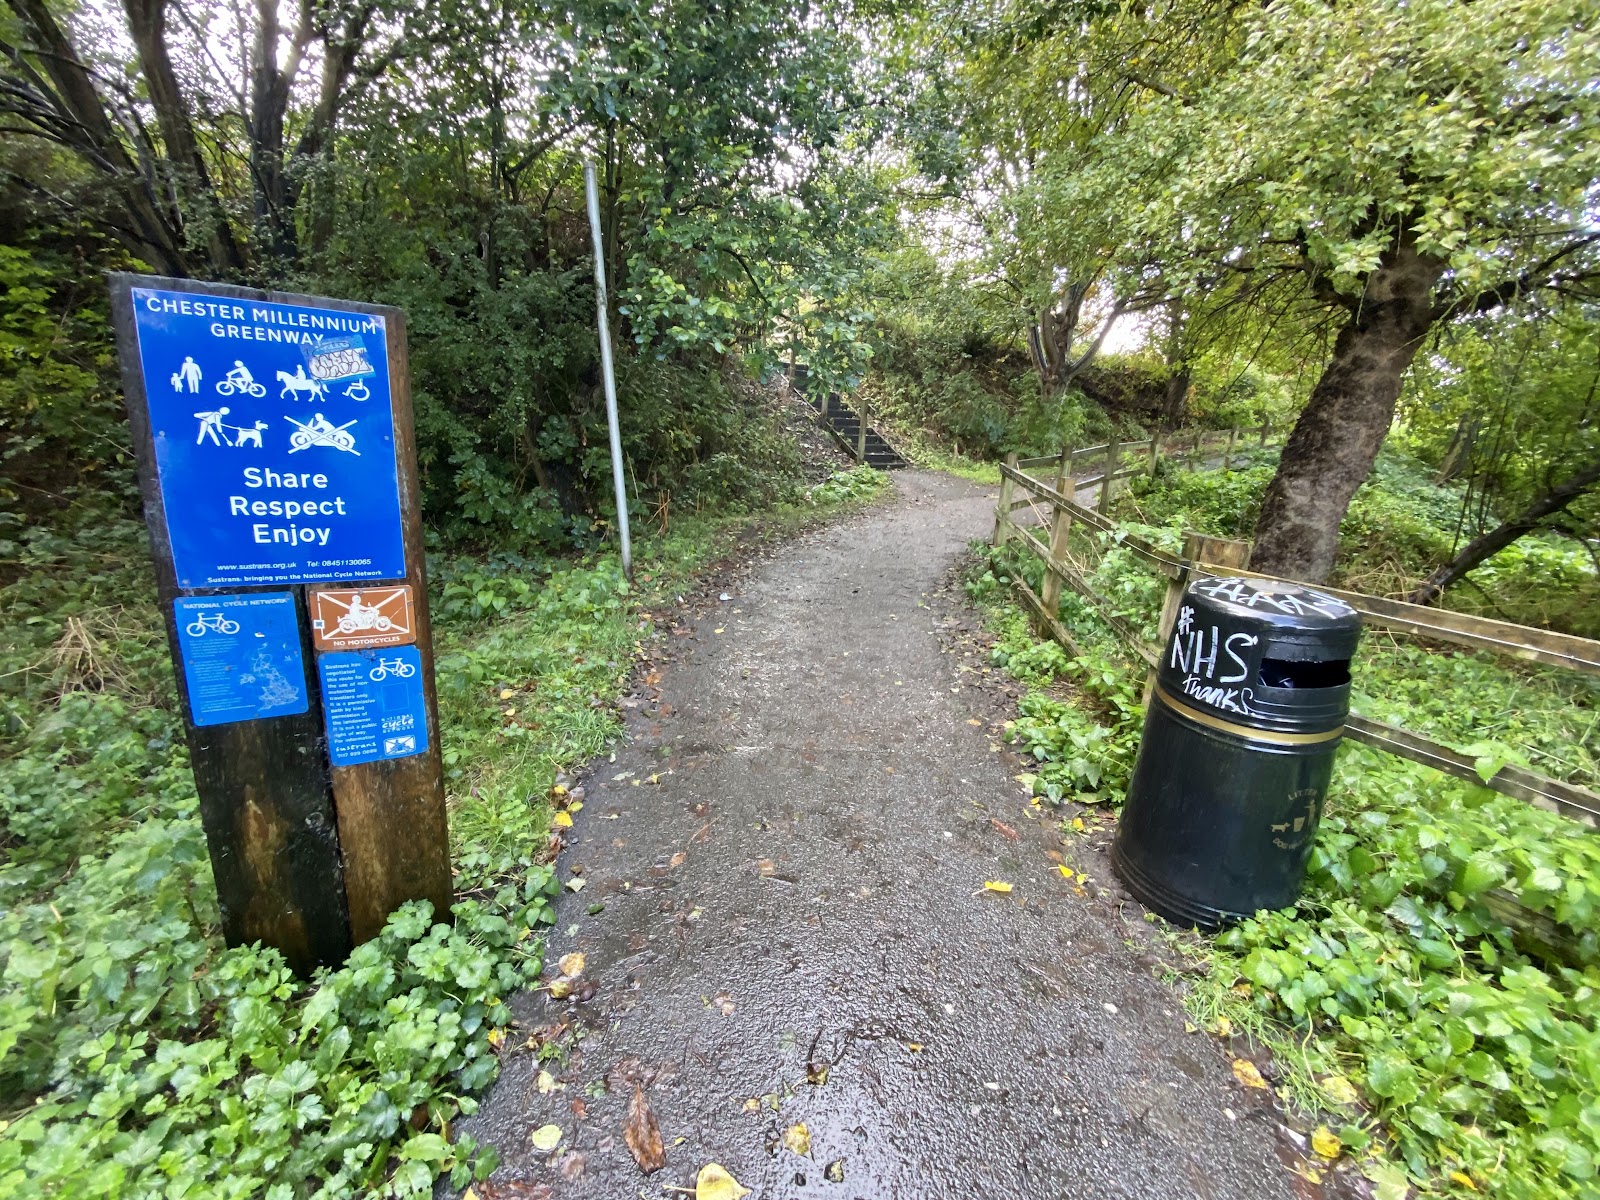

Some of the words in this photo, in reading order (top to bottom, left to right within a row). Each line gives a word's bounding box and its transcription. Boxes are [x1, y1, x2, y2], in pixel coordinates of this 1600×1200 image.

[147, 297, 245, 320] CHESTER
[252, 308, 377, 334] MILLENNIUM
[210, 323, 324, 346] GREENWAY
[243, 467, 329, 489] Share
[229, 496, 347, 519] Respect
[252, 523, 331, 546] Enjoy
[217, 561, 297, 571] www.sustrans.org.uk
[321, 558, 371, 567] 08451130065
[244, 575, 273, 583] bringing
[334, 571, 352, 579] Cycle
[250, 598, 288, 606] NETWORK
[347, 635, 401, 646] MOTORCYCLES
[1170, 626, 1259, 684] NHS
[382, 716, 415, 730] cycle
